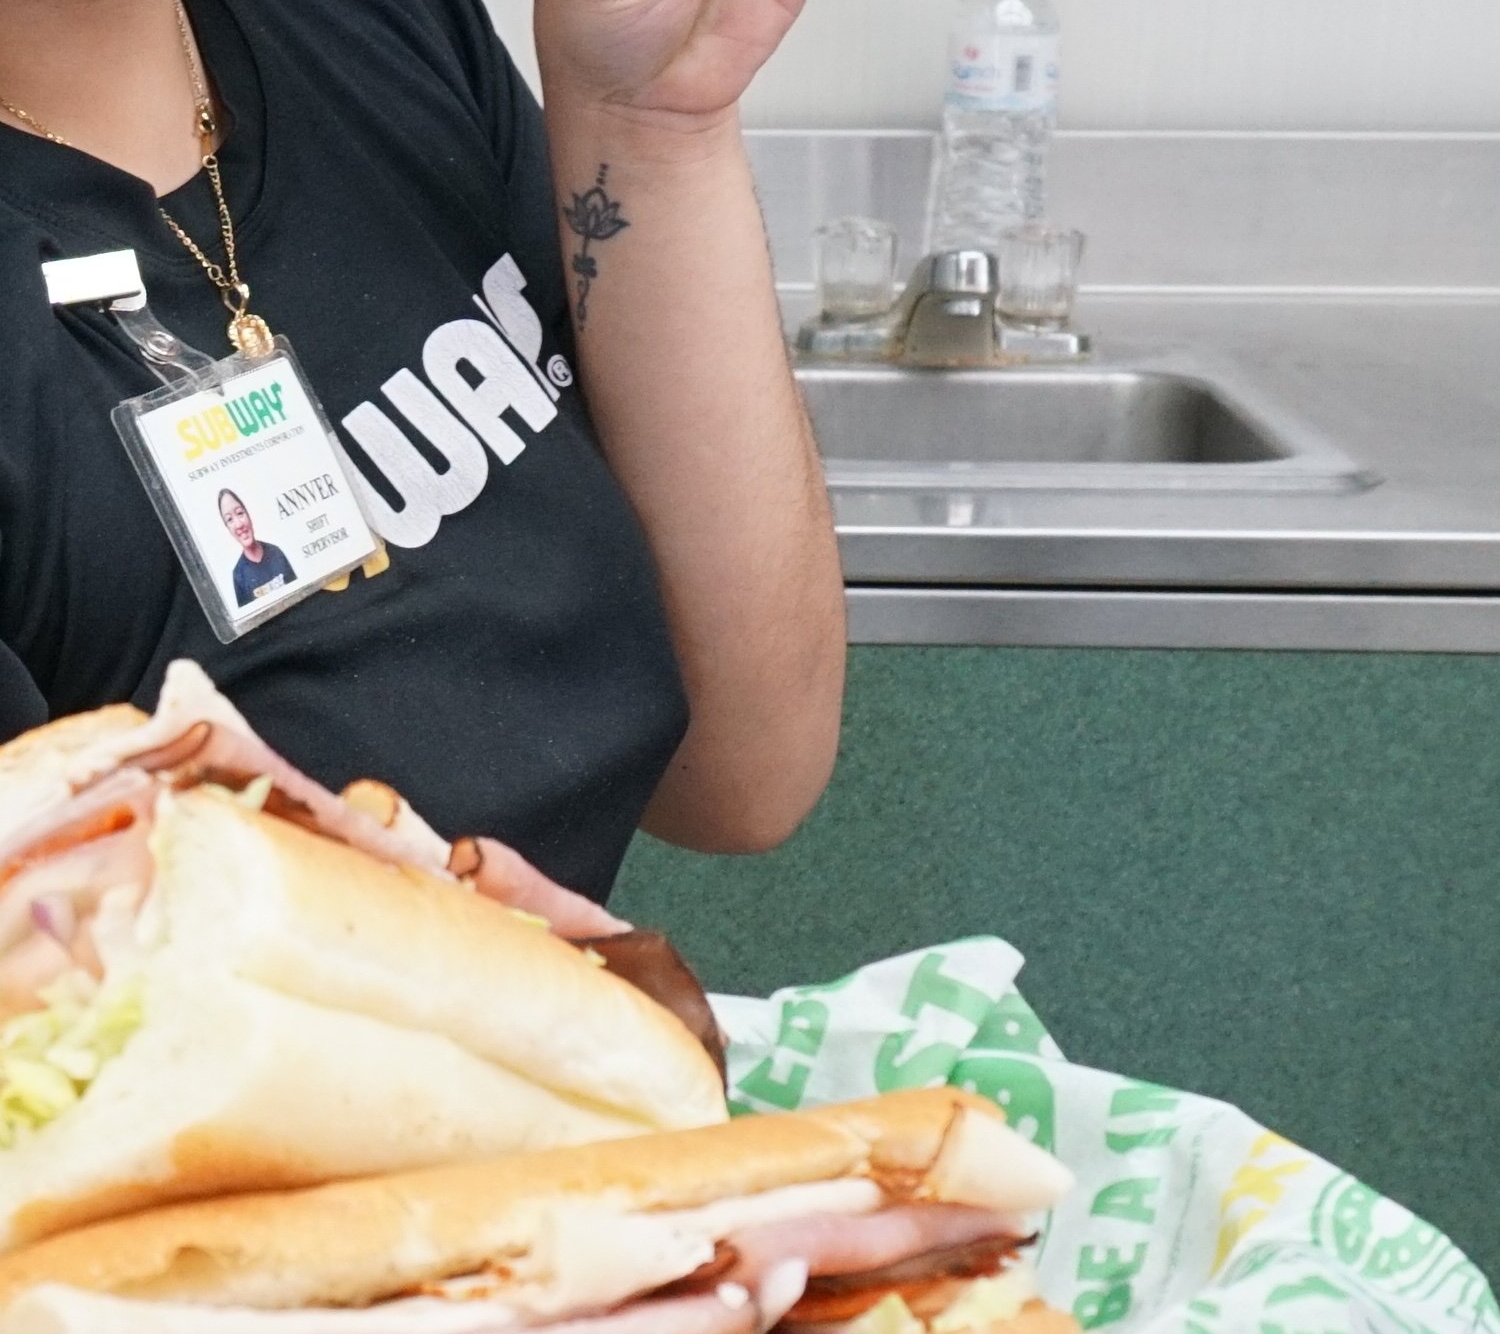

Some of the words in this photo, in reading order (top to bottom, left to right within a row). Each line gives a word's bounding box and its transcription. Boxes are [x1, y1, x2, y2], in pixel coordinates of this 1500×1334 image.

[176, 380, 288, 461] SUBWAY
[332, 253, 560, 551] WAY
[188, 461, 220, 482] SUBWAY
[274, 473, 340, 520] ANNVER
[306, 513, 331, 533] SHIFT
[301, 527, 350, 559] SUPERVISOR
